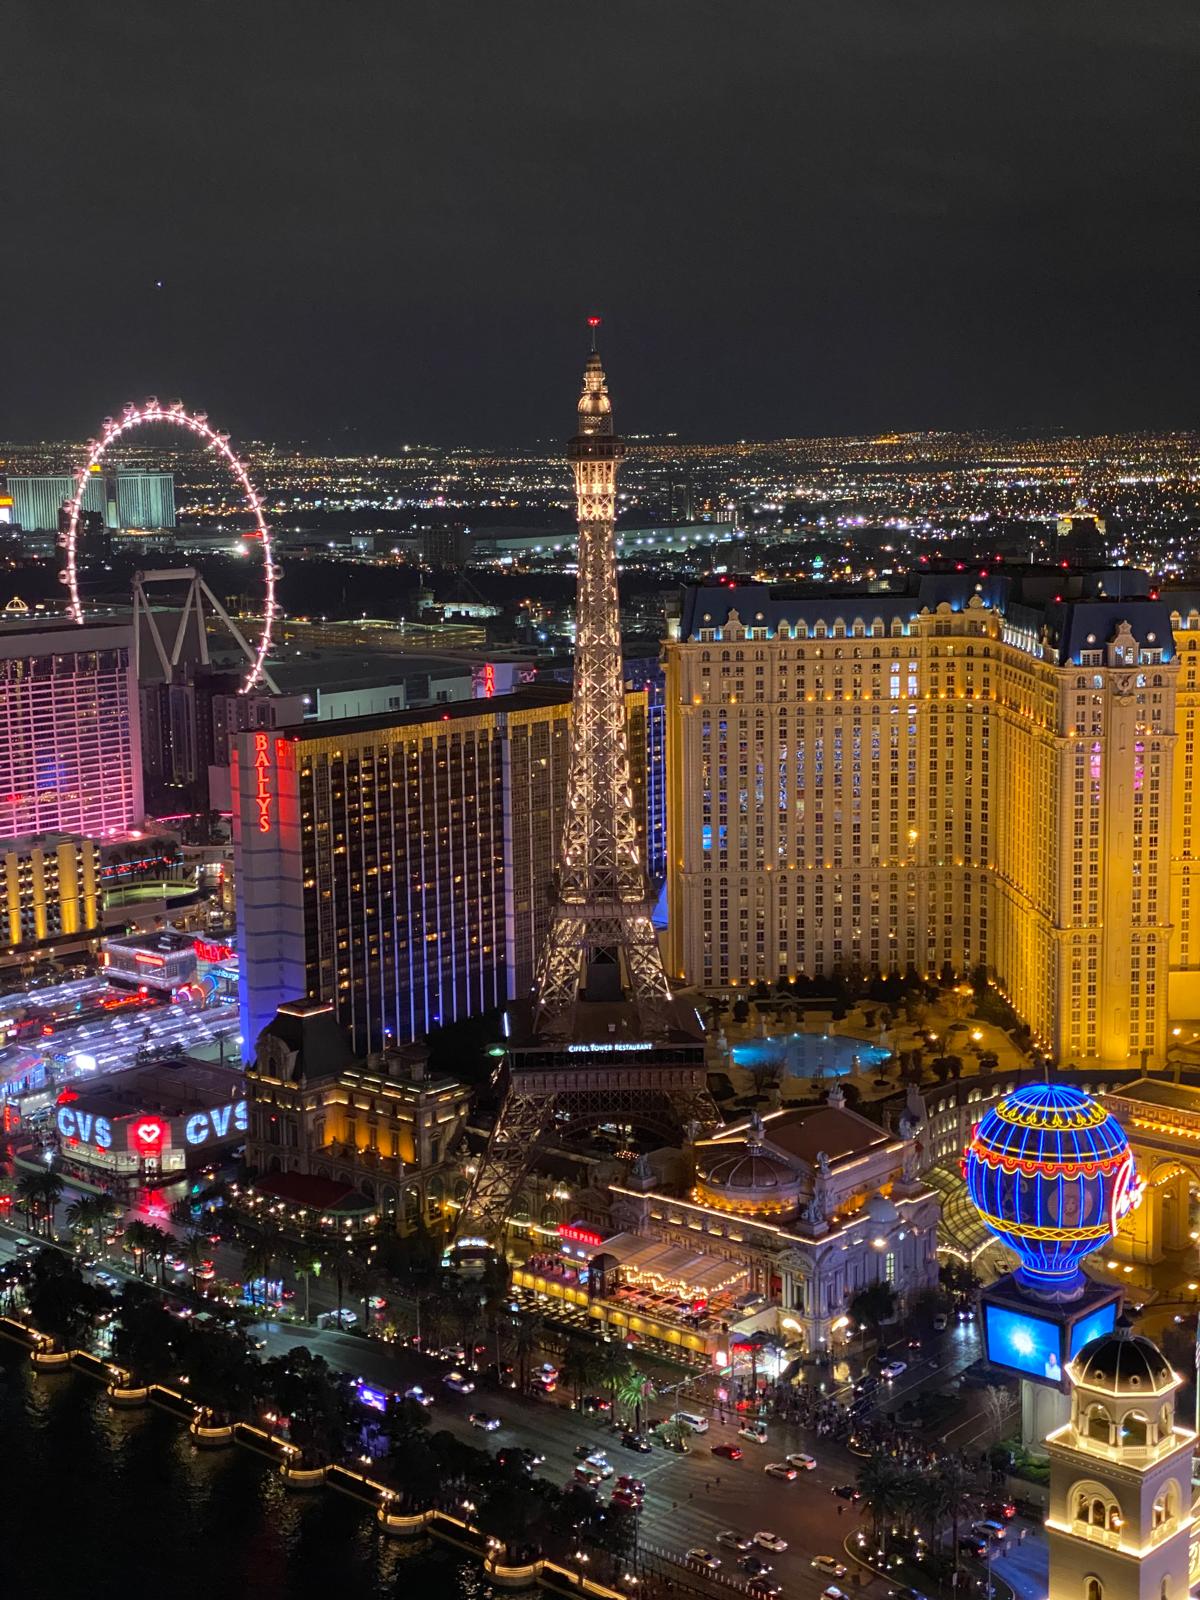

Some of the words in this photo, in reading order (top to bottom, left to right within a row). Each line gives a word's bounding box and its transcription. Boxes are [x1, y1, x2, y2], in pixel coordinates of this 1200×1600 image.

[255, 733, 271, 832] BALLYS
[614, 1042, 653, 1051] RESTAURANT
[57, 1107, 112, 1147] CVS
[186, 1101, 247, 1144] CVS
